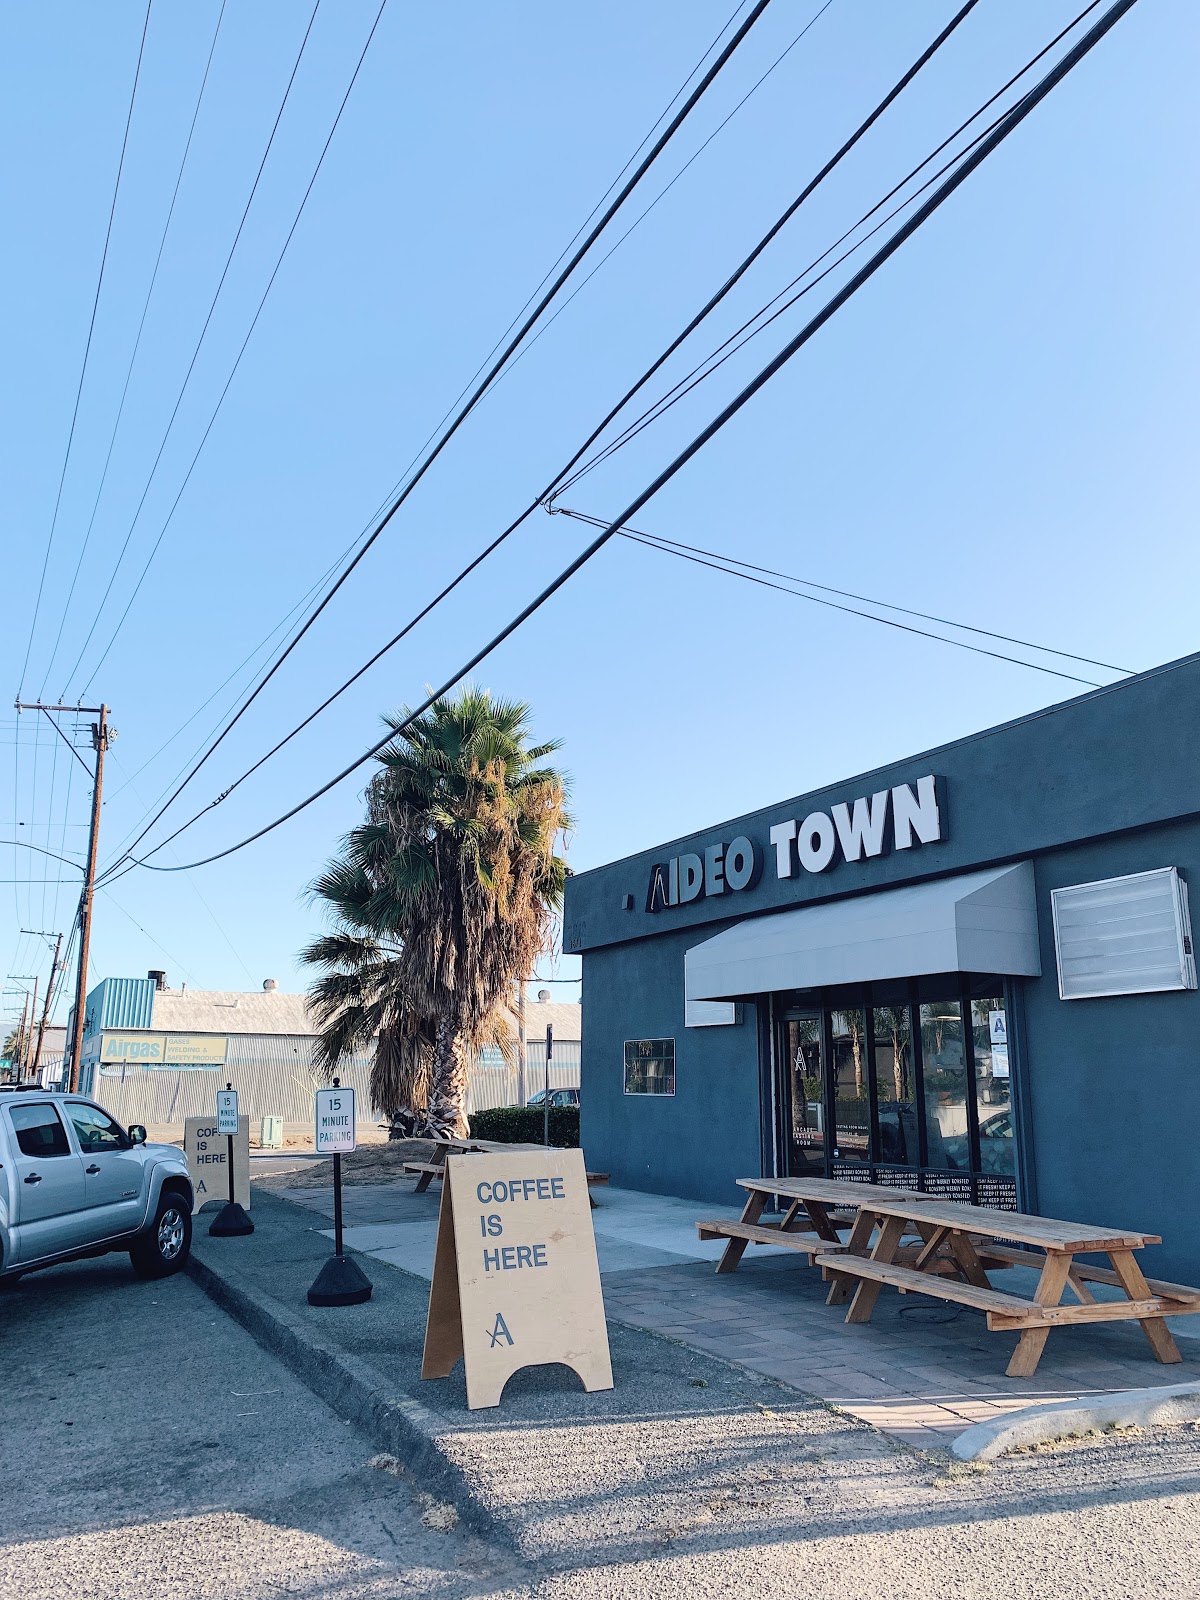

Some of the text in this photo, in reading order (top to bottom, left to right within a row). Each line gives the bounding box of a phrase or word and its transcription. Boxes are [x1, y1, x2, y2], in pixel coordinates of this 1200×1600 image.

[770, 774, 943, 880] TOWN
[994, 1017, 1006, 1033] A
[105, 1039, 161, 1059] Airgas
[224, 1097, 231, 1106] 15
[329, 1098, 342, 1111] 15
[220, 1109, 236, 1117] MINUTE
[219, 1119, 237, 1128] PARKING
[322, 1115, 349, 1127] MINUTE
[319, 1131, 351, 1143] PARKING
[197, 1141, 208, 1151] IS
[196, 1153, 227, 1165] HERE
[195, 1179, 208, 1194] A
[476, 1177, 566, 1204] COFFEE
[480, 1214, 503, 1238] IS
[483, 1243, 548, 1272] HERE
[485, 1312, 515, 1348] A
